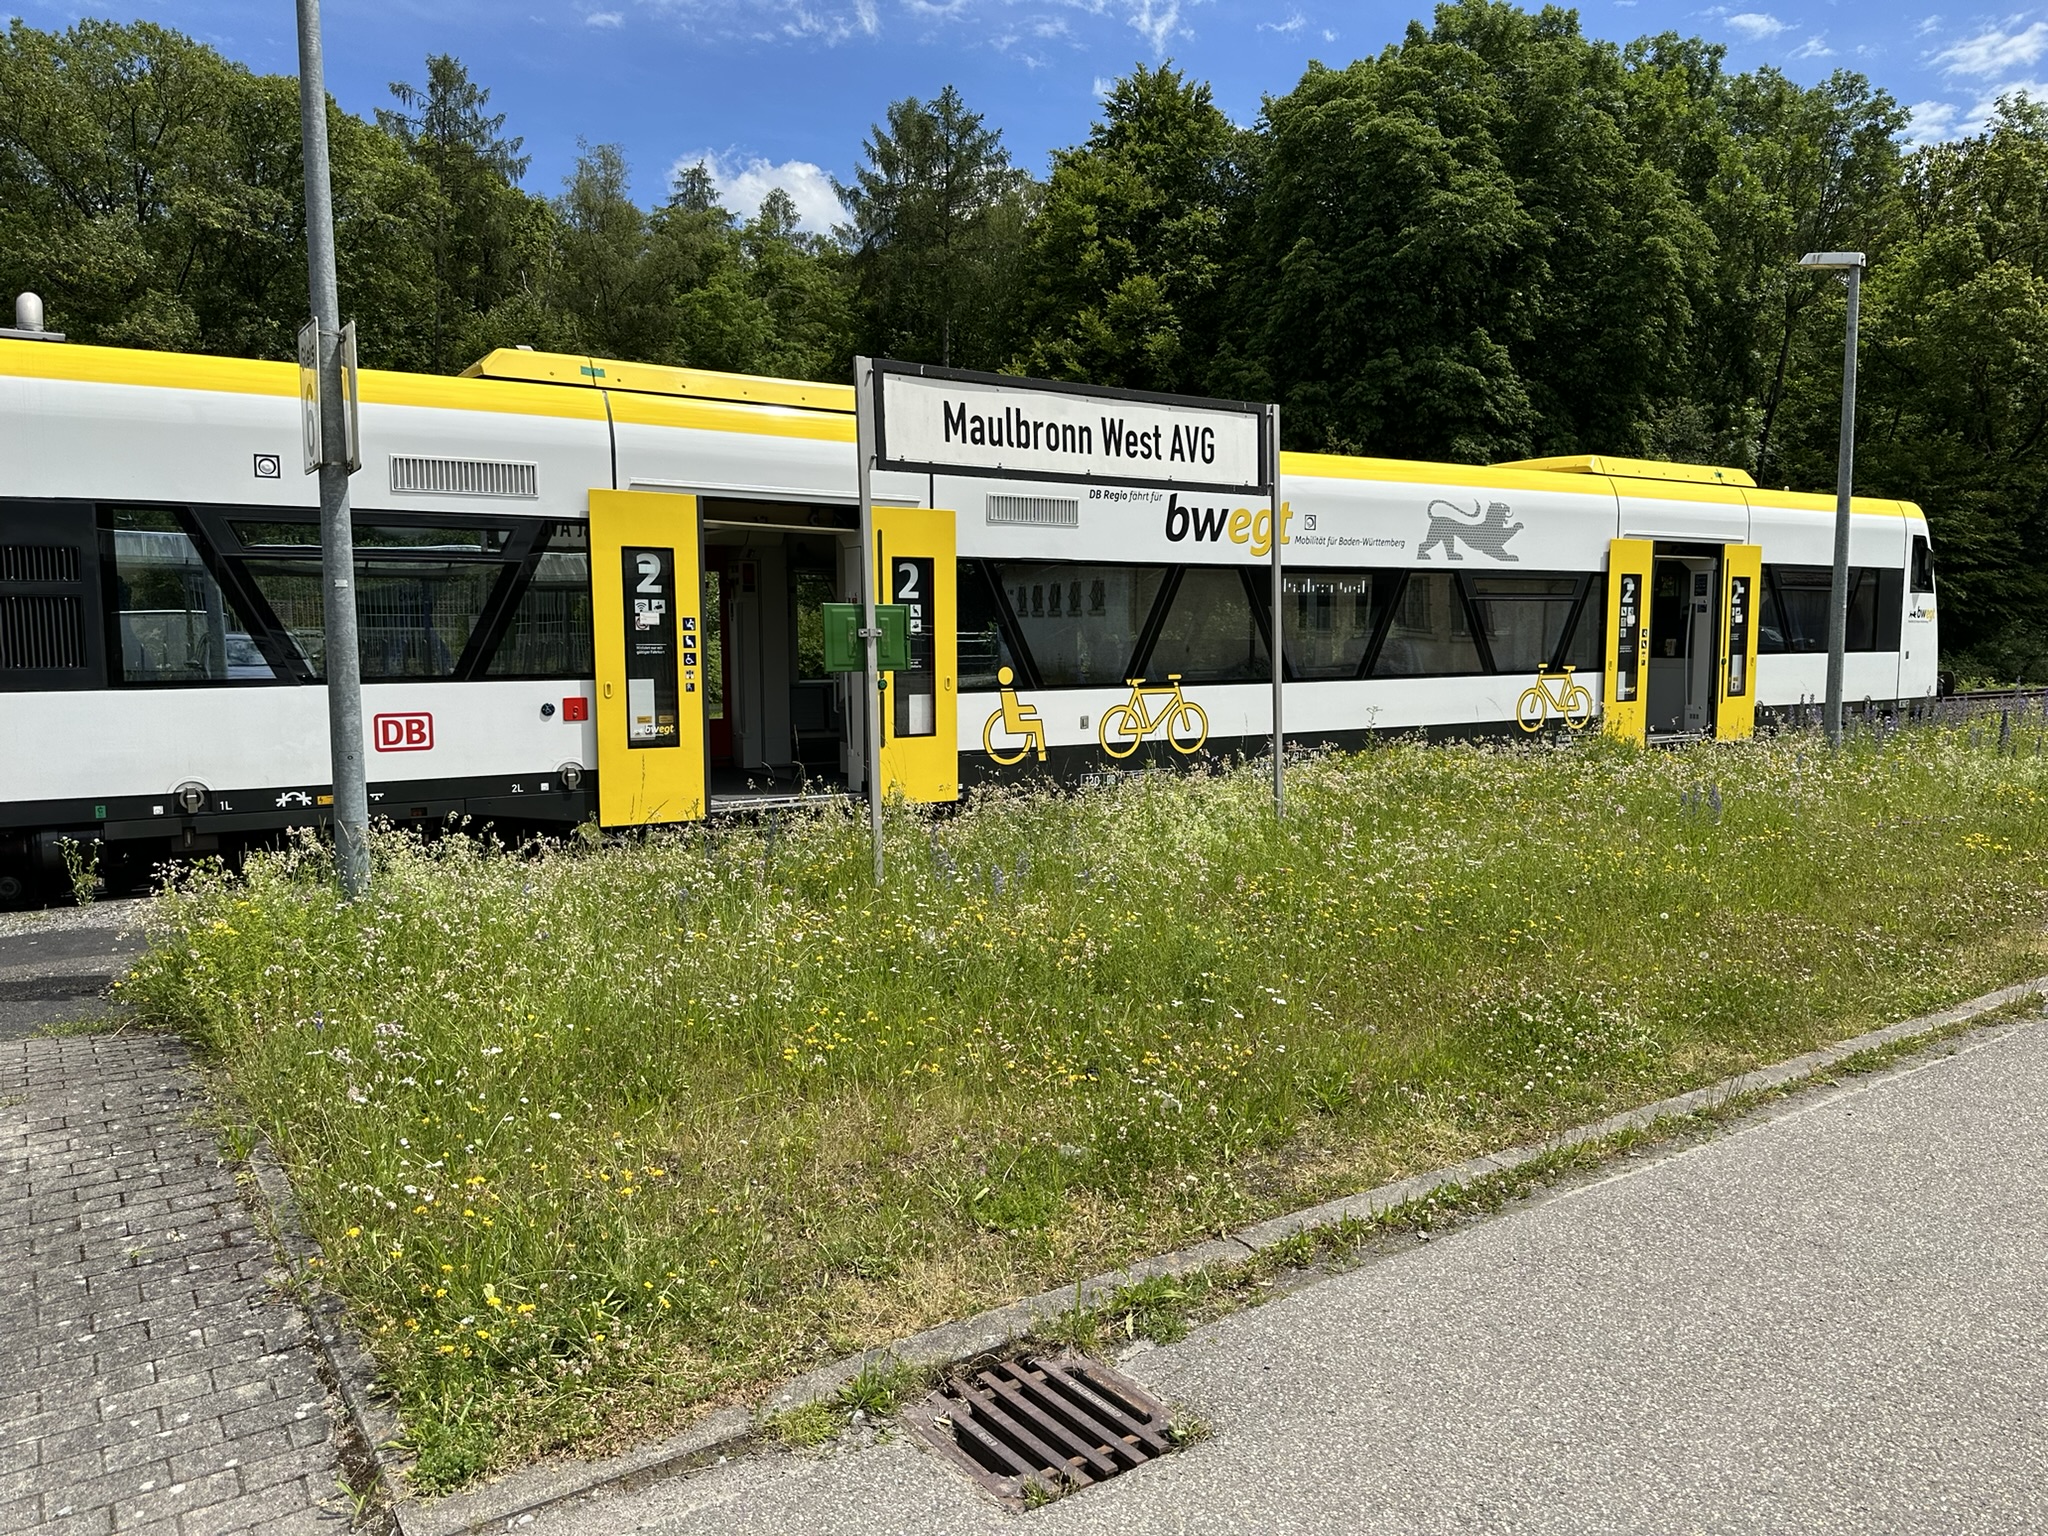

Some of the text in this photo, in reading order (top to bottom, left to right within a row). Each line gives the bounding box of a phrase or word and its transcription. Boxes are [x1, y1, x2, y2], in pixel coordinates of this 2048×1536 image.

[306, 383, 315, 458] 6
[943, 400, 1216, 465] Maulbronn West AVG
[1089, 489, 1163, 503] DB Regio fährt für
[1165, 493, 1293, 557] bwegt
[1294, 535, 1406, 549] Mobilität für Baden-Württemberg
[636, 553, 662, 593] 2
[898, 562, 920, 599] 2
[1622, 577, 1634, 603] 2
[1732, 580, 1742, 604] 2
[381, 719, 427, 746] DB
[645, 724, 674, 735] bwegt
[511, 783, 524, 793] 2L
[219, 800, 233, 811] 1L
